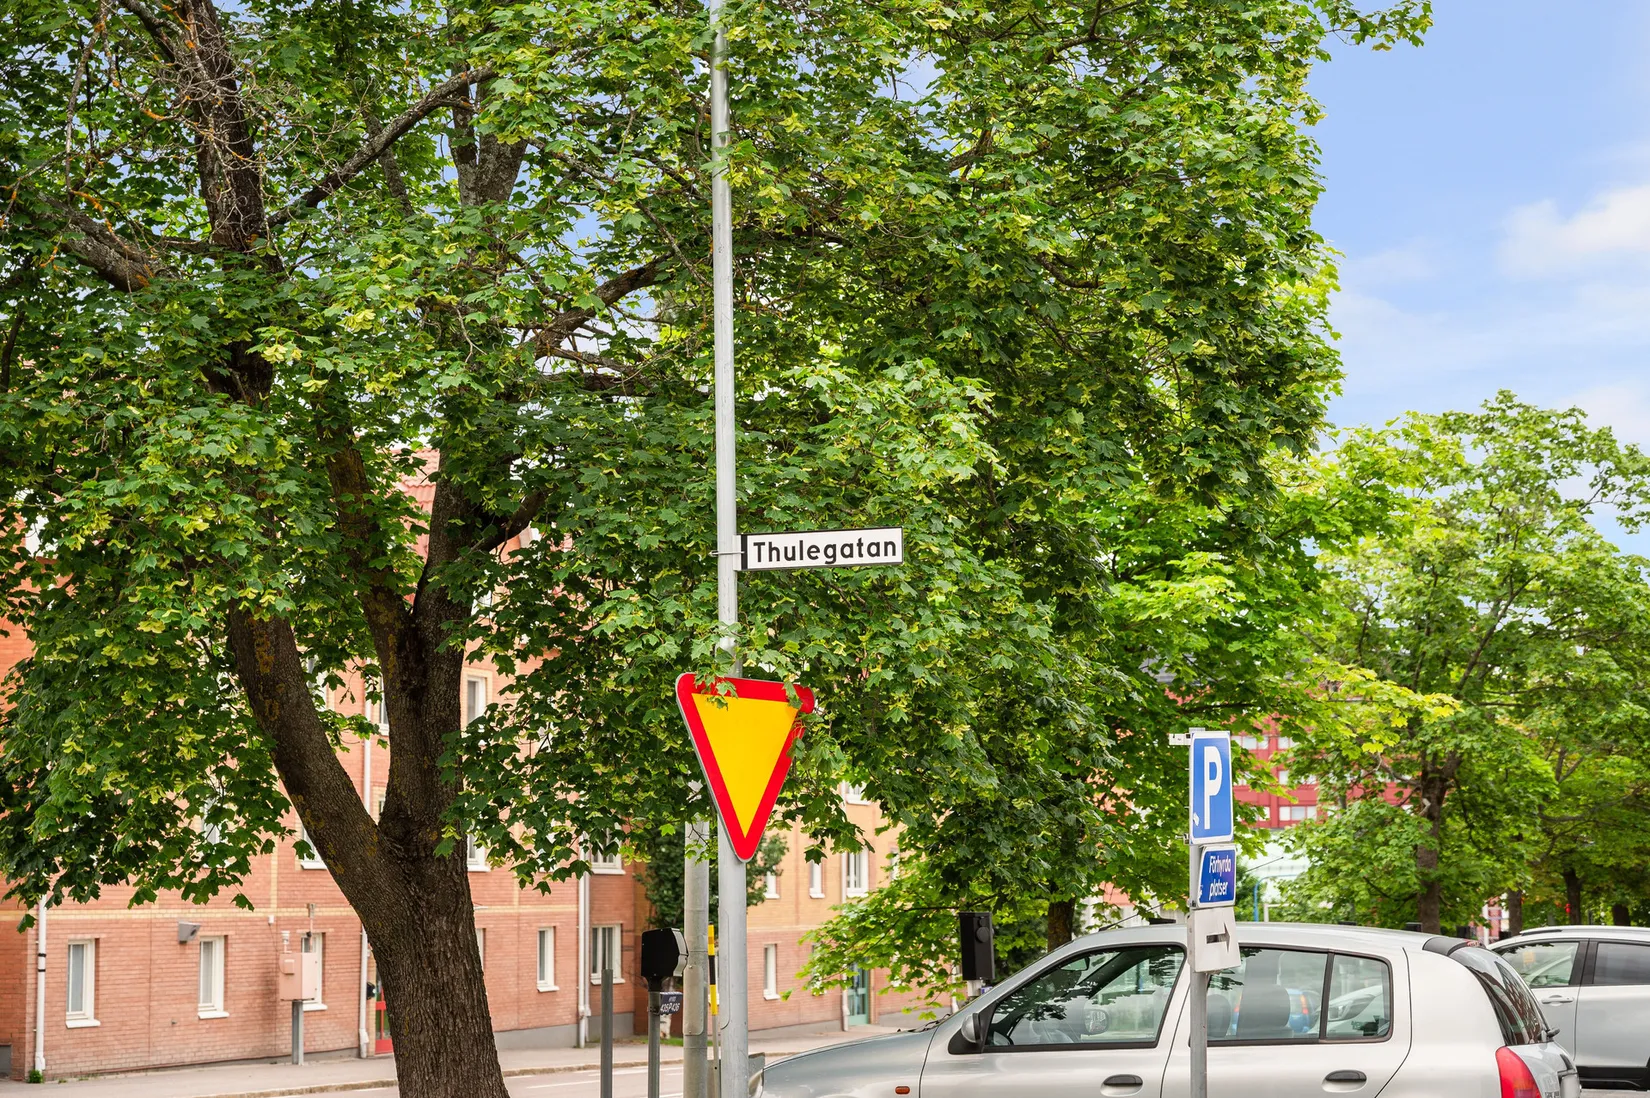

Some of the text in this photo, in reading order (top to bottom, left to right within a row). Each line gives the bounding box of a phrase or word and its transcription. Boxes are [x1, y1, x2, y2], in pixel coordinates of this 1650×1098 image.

[753, 537, 897, 564] Thulegatan
[1204, 745, 1223, 830] P
[1209, 854, 1232, 877] Förhyrda
[1209, 878, 1228, 901] platser
